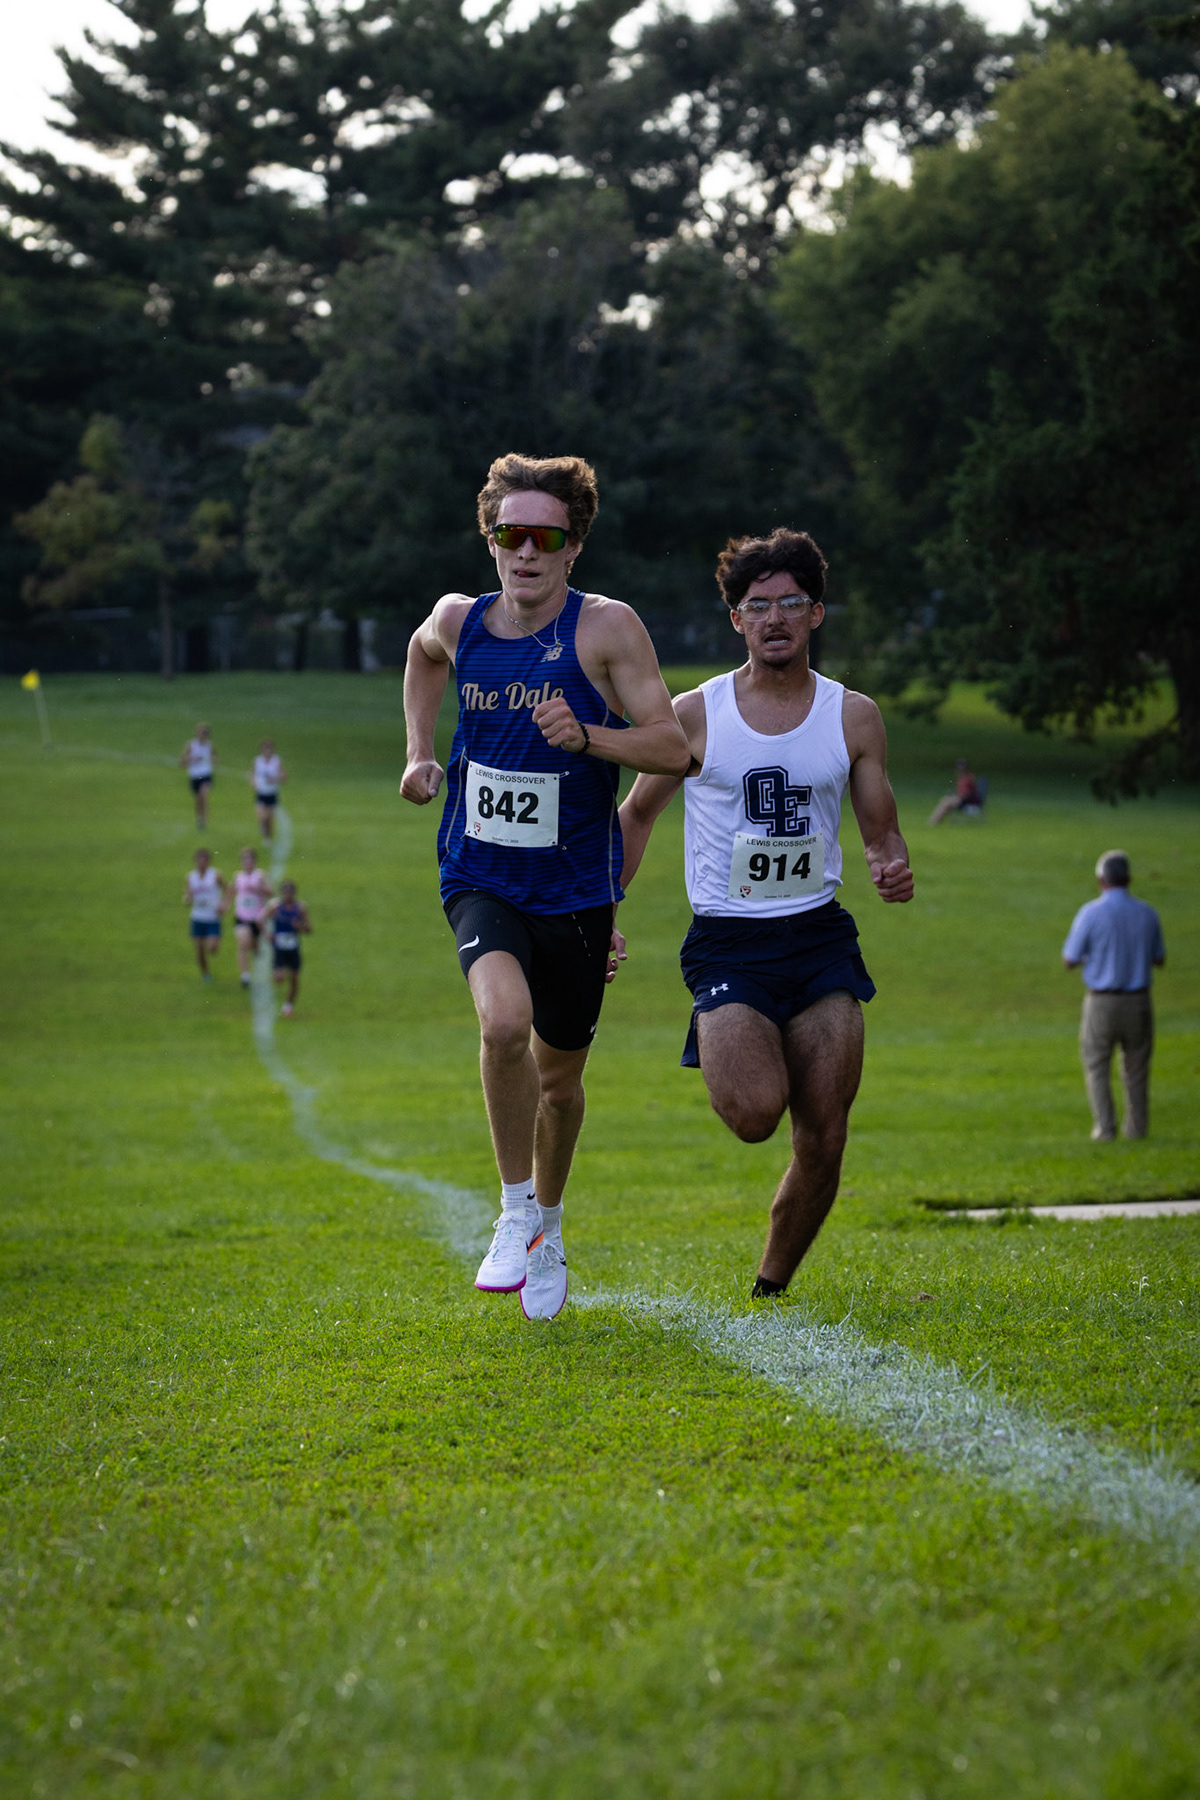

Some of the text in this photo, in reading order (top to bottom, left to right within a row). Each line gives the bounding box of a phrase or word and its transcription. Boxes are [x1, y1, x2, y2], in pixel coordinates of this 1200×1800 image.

[461, 682, 500, 711] The
[475, 768, 546, 785] LEWIS CROSSOVER
[477, 785, 539, 825] 842
[746, 837, 817, 848] LEWIS CROSSOVER
[748, 851, 811, 882] 914
